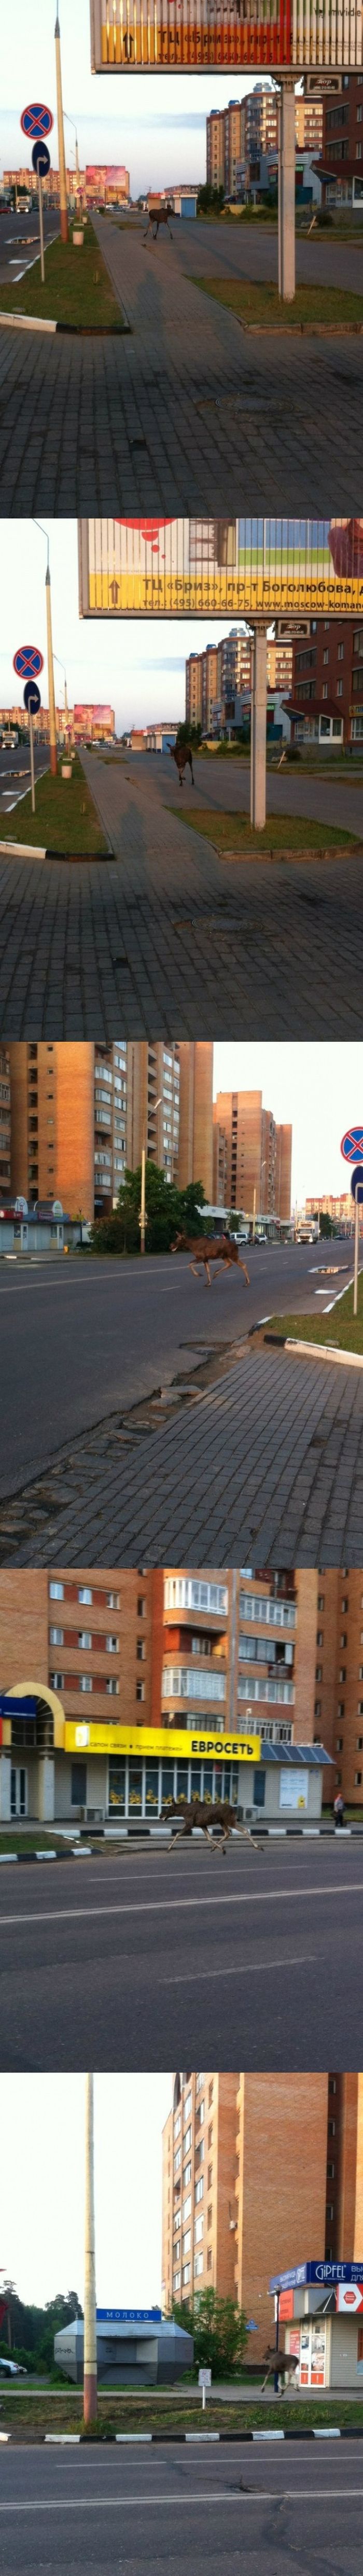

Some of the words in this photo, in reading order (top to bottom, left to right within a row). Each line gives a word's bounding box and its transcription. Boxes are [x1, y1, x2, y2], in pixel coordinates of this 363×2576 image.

[158, 31, 179, 45] ТЦ
[143, 579, 163, 592] ТЦ
[167, 580, 222, 593] «Бриз»,
[228, 583, 258, 594] пр-т
[263, 581, 355, 595] Боголюбова,
[170, 598, 194, 608] (495)
[191, 1740, 254, 1755] ЕВРОСЕТЬ
